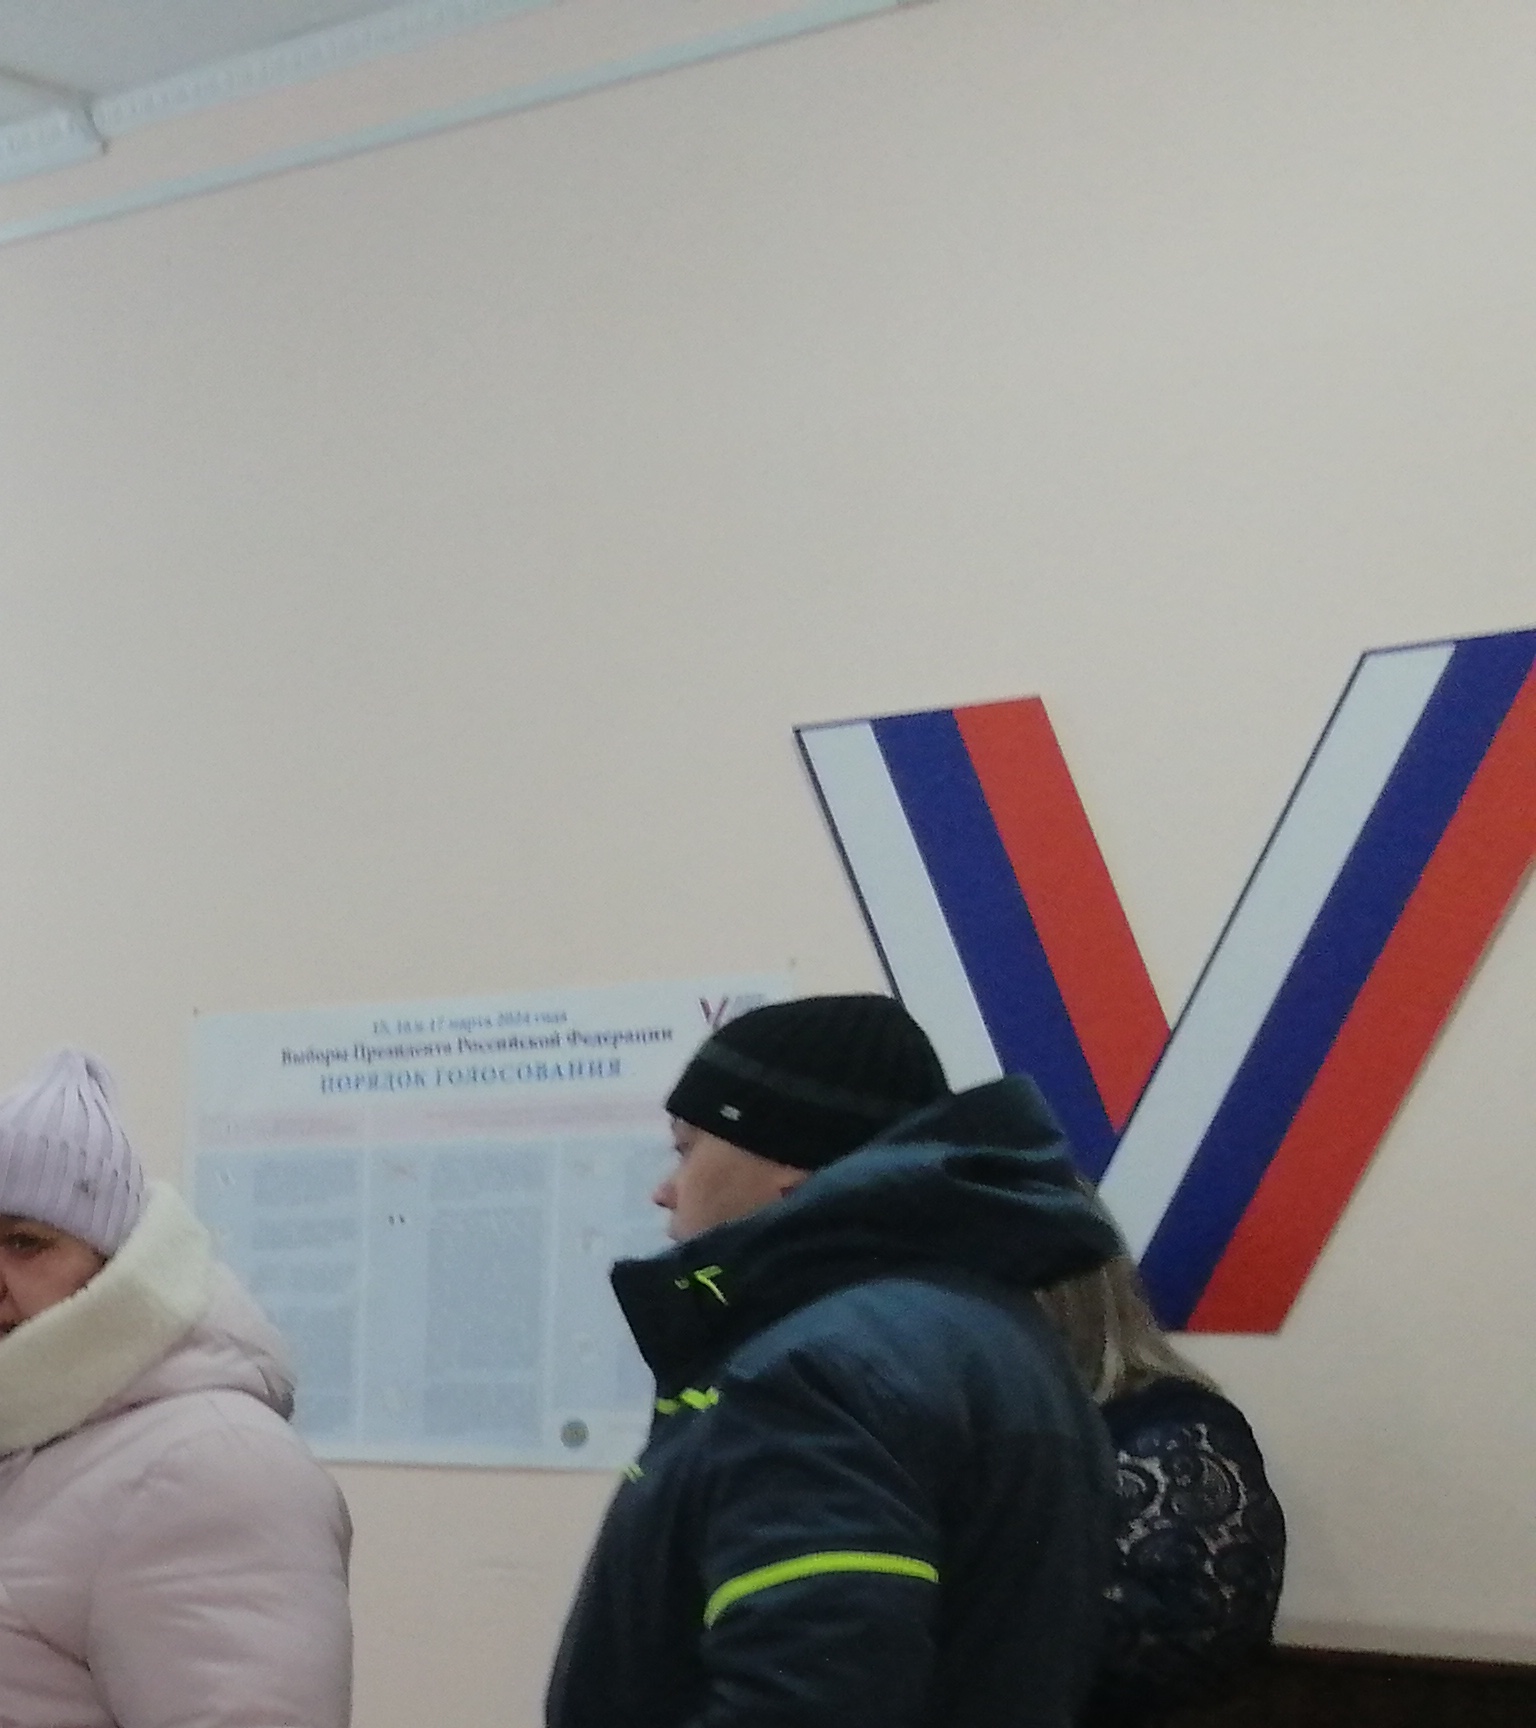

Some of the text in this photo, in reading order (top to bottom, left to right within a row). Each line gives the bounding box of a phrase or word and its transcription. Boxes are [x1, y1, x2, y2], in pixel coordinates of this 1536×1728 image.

[281, 1026, 674, 1068] Выборы Президента Российской Федерации
[320, 1057, 623, 1095] ПОРЯДОК ГОЛОСОВАНИЯ
